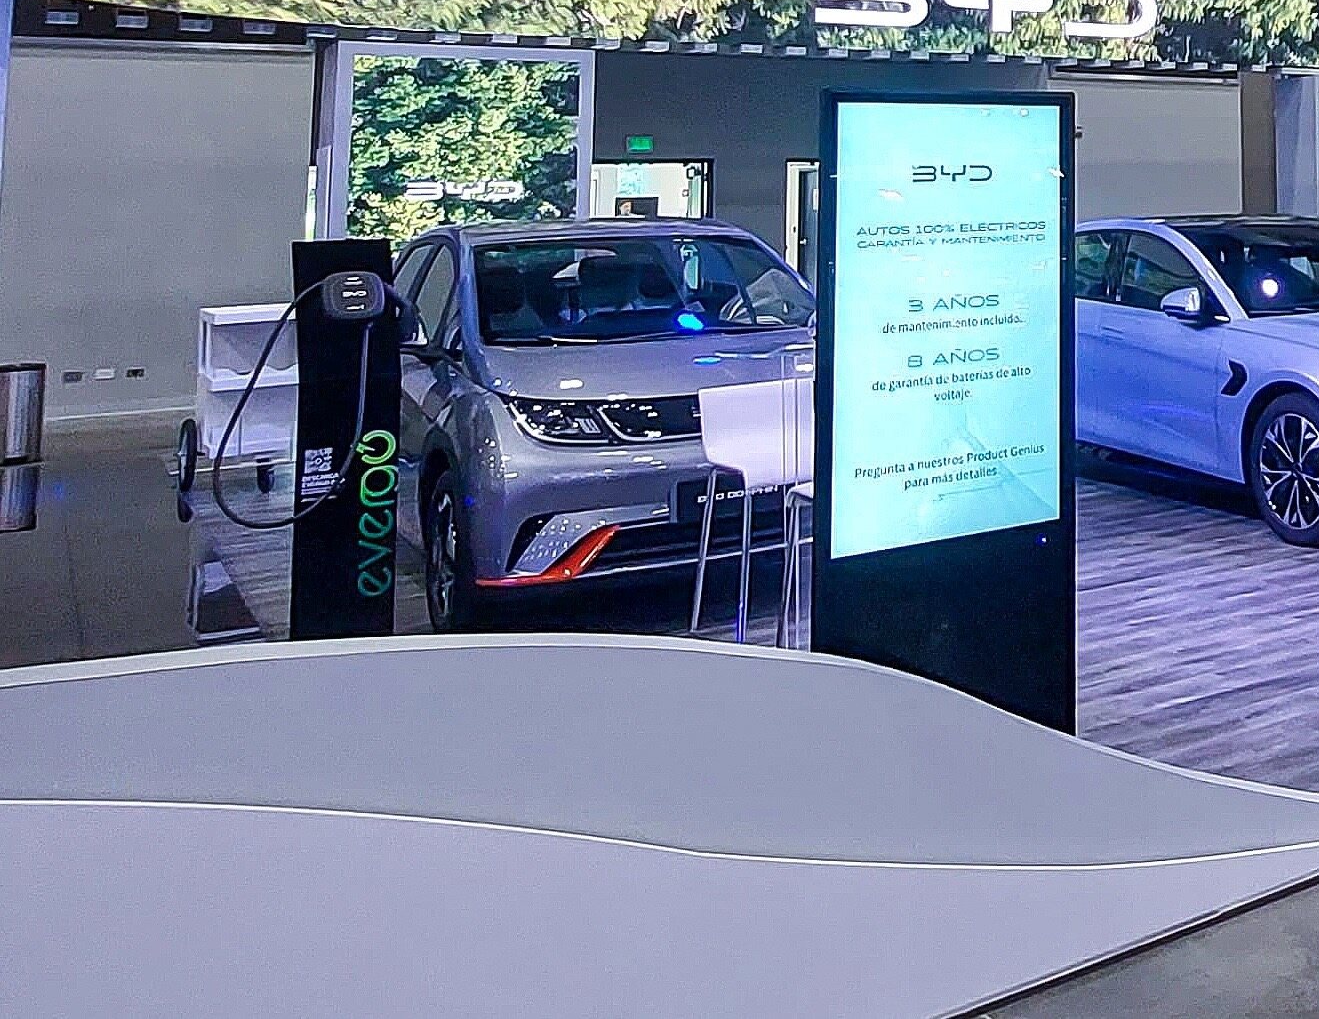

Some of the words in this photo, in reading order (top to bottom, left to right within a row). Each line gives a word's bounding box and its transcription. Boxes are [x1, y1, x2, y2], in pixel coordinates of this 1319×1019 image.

[912, 165, 993, 182] BYD
[403, 180, 525, 202] BYD
[856, 226, 910, 236] AUTOS
[916, 224, 955, 233] 100%
[908, 299, 924, 312] 3
[933, 294, 1000, 311] AÑOS
[882, 323, 897, 334] de
[907, 355, 923, 368] 8
[933, 348, 1000, 365] AÑOS
[872, 381, 886, 391] de
[935, 375, 950, 385] de
[996, 367, 1009, 378] de
[1010, 366, 1031, 377] alto
[854, 463, 906, 479] Pregunta
[908, 462, 915, 471] a
[917, 453, 964, 470] nuestros
[966, 448, 1008, 462] Product
[1010, 444, 1045, 456] Genius
[903, 478, 929, 491] para
[697, 493, 725, 503] BD
